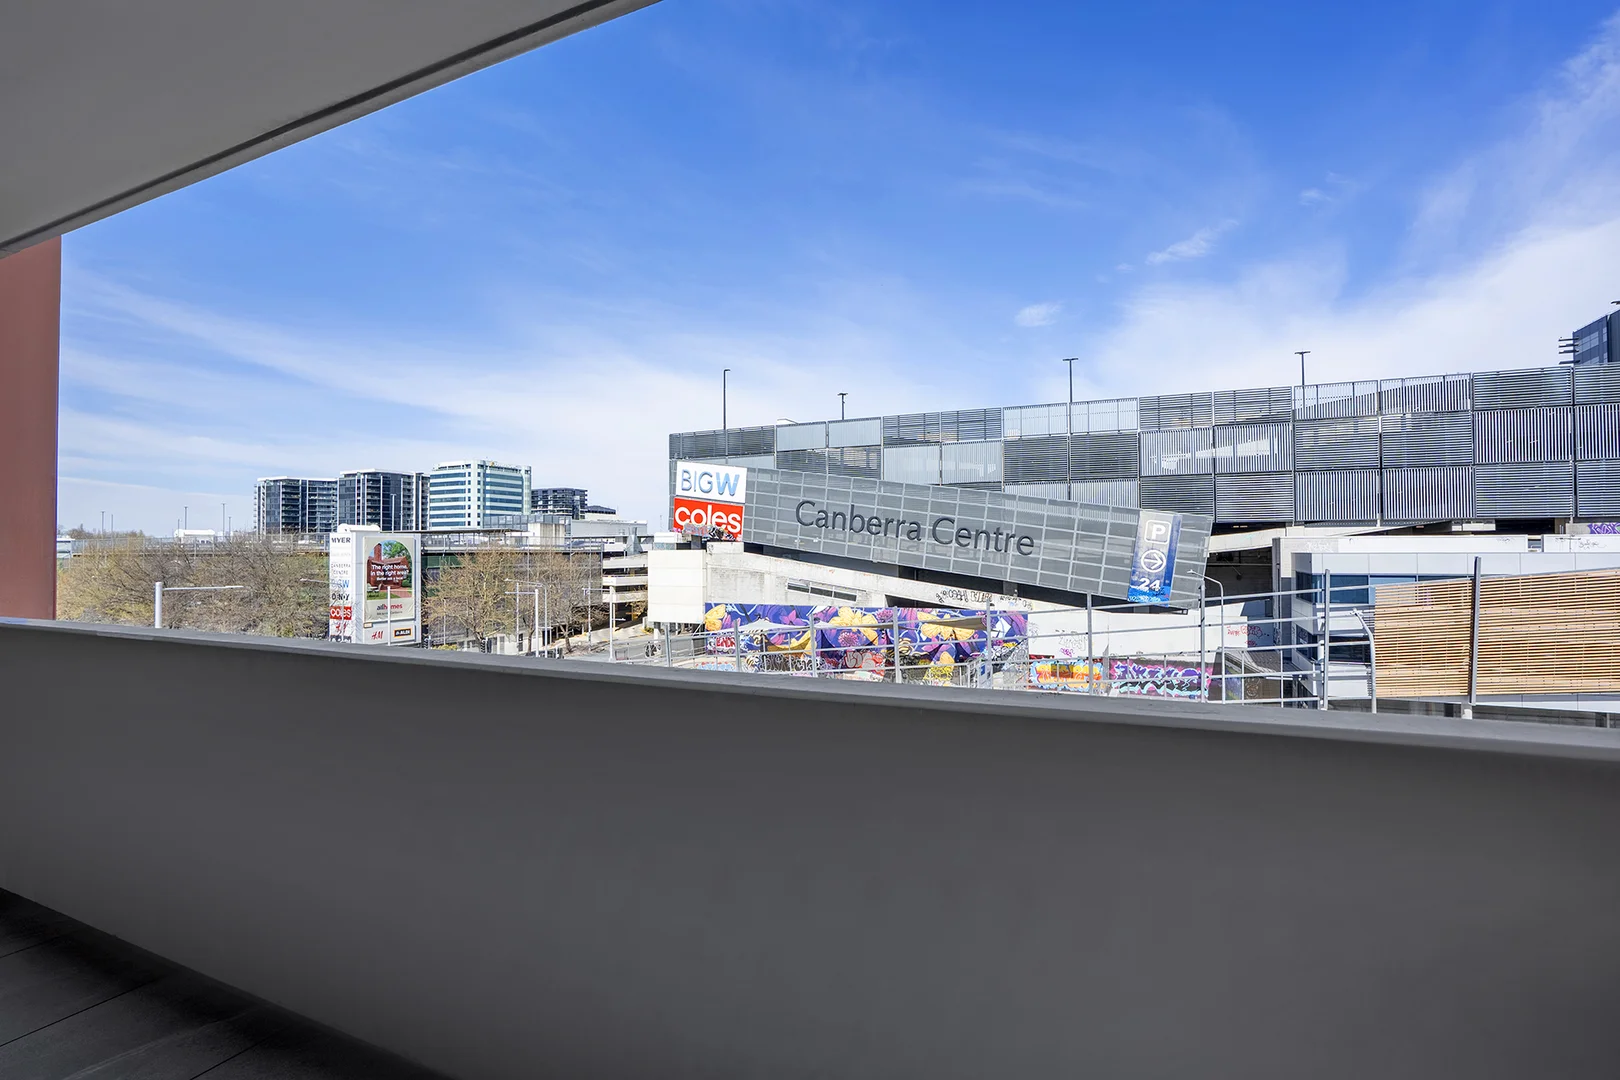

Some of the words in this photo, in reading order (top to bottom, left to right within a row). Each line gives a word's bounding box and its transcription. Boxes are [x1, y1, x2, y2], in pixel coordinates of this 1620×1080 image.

[674, 504, 741, 534] coles
[794, 500, 922, 541] Canberra
[931, 516, 1036, 556] Centre
[1150, 523, 1166, 537] P
[331, 608, 351, 617] coes
